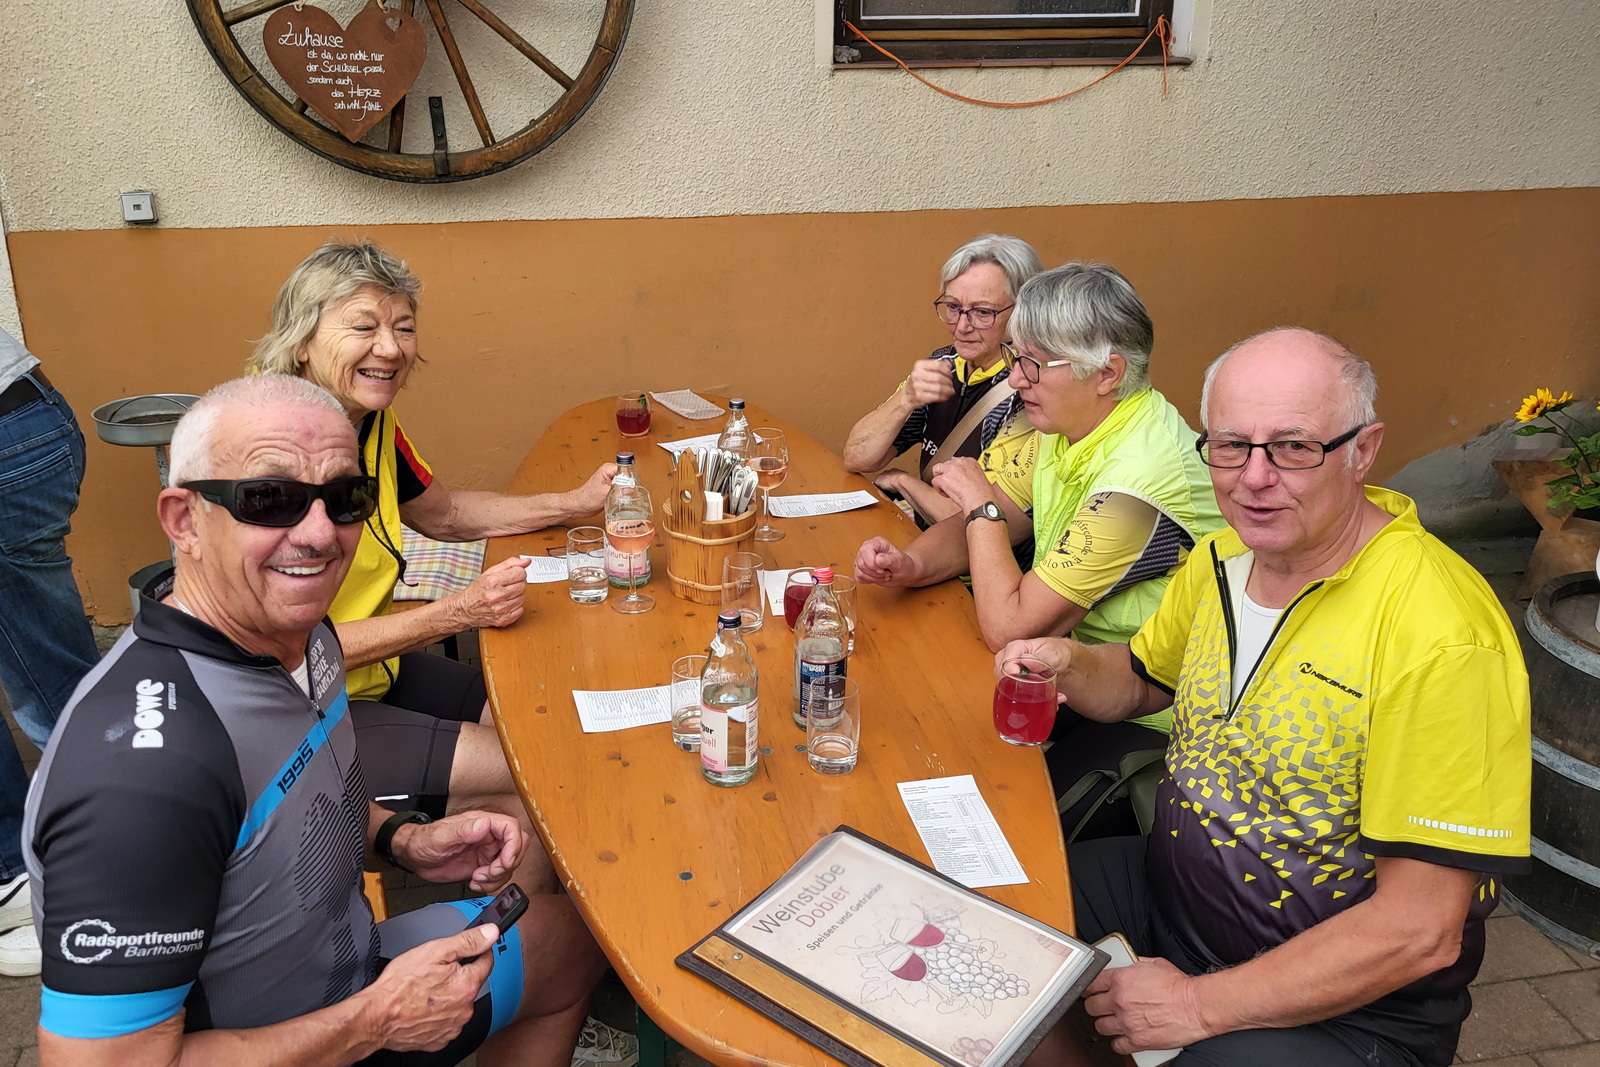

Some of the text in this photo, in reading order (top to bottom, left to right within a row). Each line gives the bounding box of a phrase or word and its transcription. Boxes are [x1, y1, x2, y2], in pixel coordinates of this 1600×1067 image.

[278, 21, 344, 48] Zuhause
[307, 49, 318, 58] ist
[336, 53, 348, 61] wo
[350, 50, 370, 61] nicht
[371, 52, 385, 61] nur
[306, 62, 320, 72] der
[307, 75, 333, 84] sondern
[331, 84, 382, 100] das HERZ
[334, 100, 347, 110] sich
[347, 99, 361, 110] wohl
[277, 743, 314, 795] 1995
[752, 863, 846, 934] Weinstube
[795, 884, 850, 928] Dobler
[806, 882, 884, 952] Speisen und Getränke
[74, 928, 205, 949] Radsportfreunde
[124, 940, 204, 958] Bartholomä
